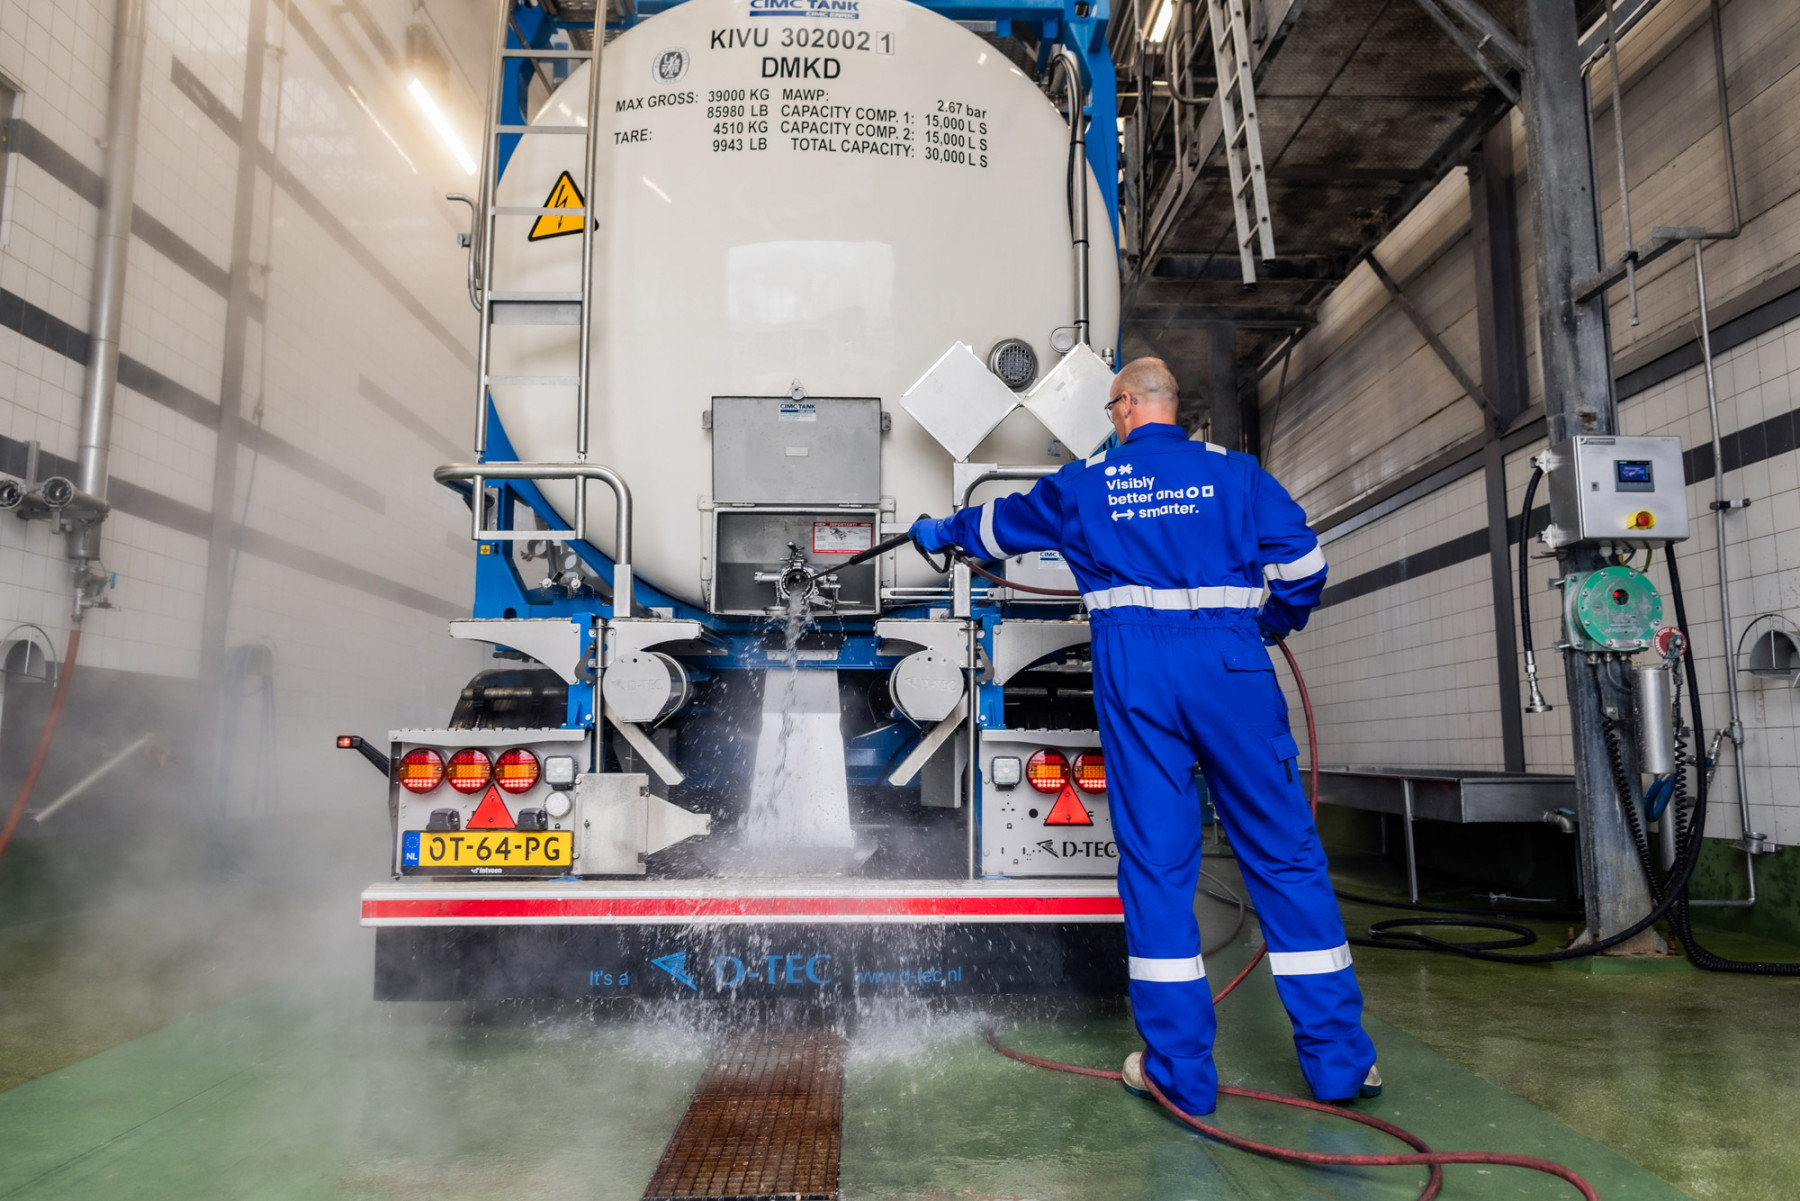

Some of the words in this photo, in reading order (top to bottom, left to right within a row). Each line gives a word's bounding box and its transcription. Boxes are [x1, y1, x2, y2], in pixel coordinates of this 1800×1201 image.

[750, 0, 802, 8] CIMC
[807, 0, 859, 10] TANK
[710, 28, 768, 50] KIVU
[781, 28, 870, 51] 302002
[881, 33, 890, 54] 1
[762, 56, 841, 79] DMKD
[616, 97, 644, 112] MAX
[647, 91, 699, 108] GROSS:
[708, 89, 746, 102] 39000
[750, 88, 770, 101] KG
[706, 105, 745, 118] 85980
[751, 104, 769, 117] LB
[782, 88, 830, 102] MAWP:
[937, 100, 963, 114] 2.67
[966, 104, 987, 119] bar
[781, 104, 852, 119] CAPACITY
[855, 108, 899, 123] COMP.
[903, 112, 915, 124] 1:
[925, 114, 965, 132] 15,000
[968, 120, 976, 133] L
[980, 122, 988, 135] S
[614, 128, 652, 145] TARE:
[713, 122, 744, 135] 4510
[748, 120, 768, 134] KG
[780, 120, 851, 136] CAPACITY
[855, 124, 899, 140] COMP.
[903, 128, 915, 141] 2:
[925, 130, 965, 148] 15,000
[968, 136, 976, 150] L
[980, 138, 988, 152] S
[712, 138, 744, 152] 9943
[750, 138, 768, 150] LB
[791, 138, 837, 152] TOTAL
[840, 139, 915, 158] CAPACITY:
[925, 146, 966, 164] 30,000
[968, 152, 976, 166] L
[980, 154, 988, 168] S
[1106, 476, 1155, 490] Visibly
[1108, 492, 1154, 506] better
[1156, 488, 1184, 500] and
[1138, 503, 1200, 518] smarter.
[406, 853, 418, 861] NL
[430, 836, 560, 861] OT-64-PG
[1062, 842, 1118, 858] D-TEC
[590, 970, 613, 986] It's
[618, 973, 629, 986] a
[716, 954, 832, 986] D-TEC
